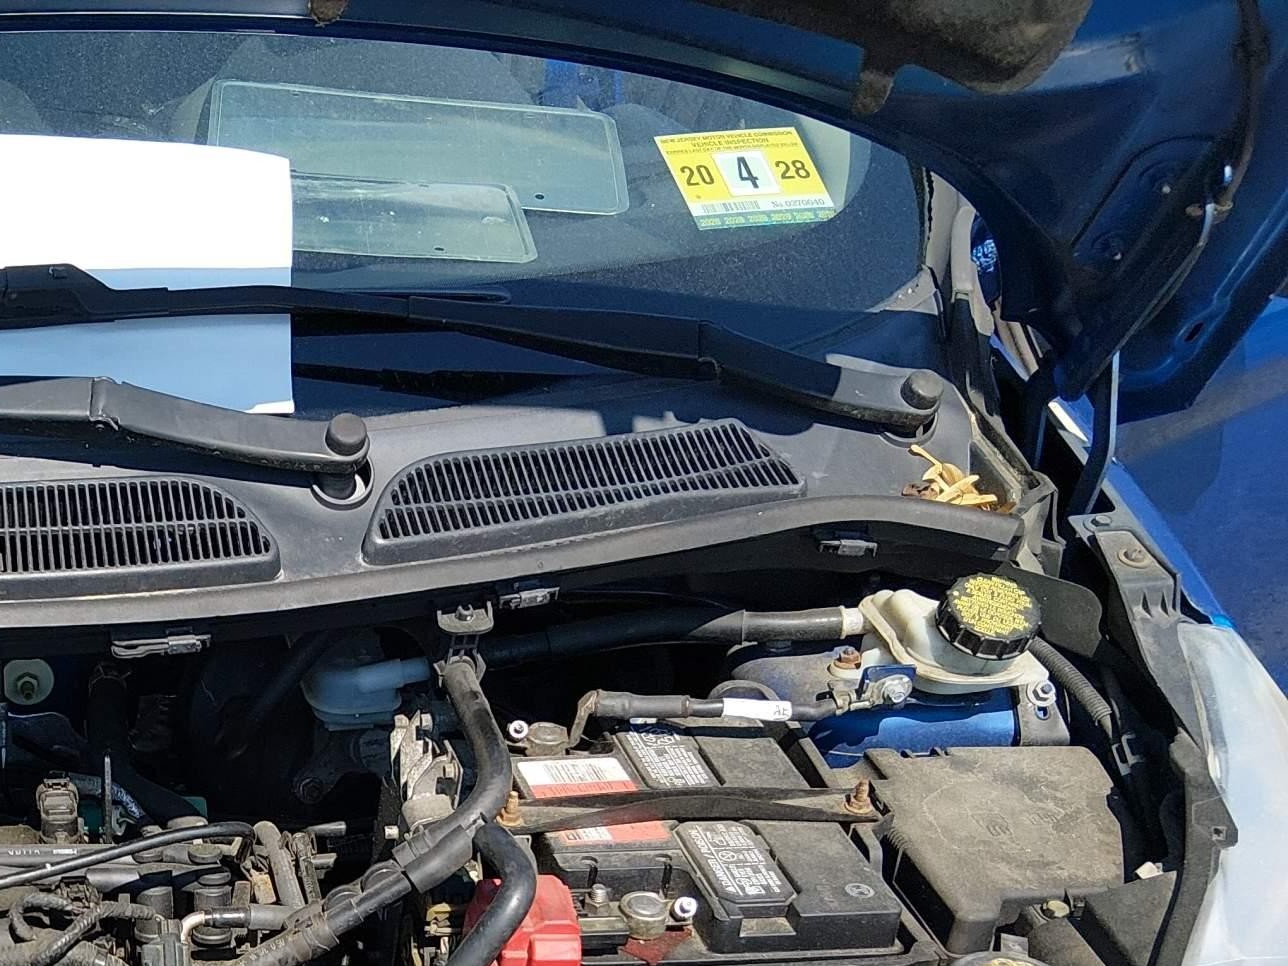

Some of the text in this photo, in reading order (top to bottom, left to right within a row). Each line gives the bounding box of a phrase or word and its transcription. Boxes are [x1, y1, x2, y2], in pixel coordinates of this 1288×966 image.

[680, 164, 715, 187] 20
[736, 156, 760, 189] 4
[775, 159, 811, 180] 28
